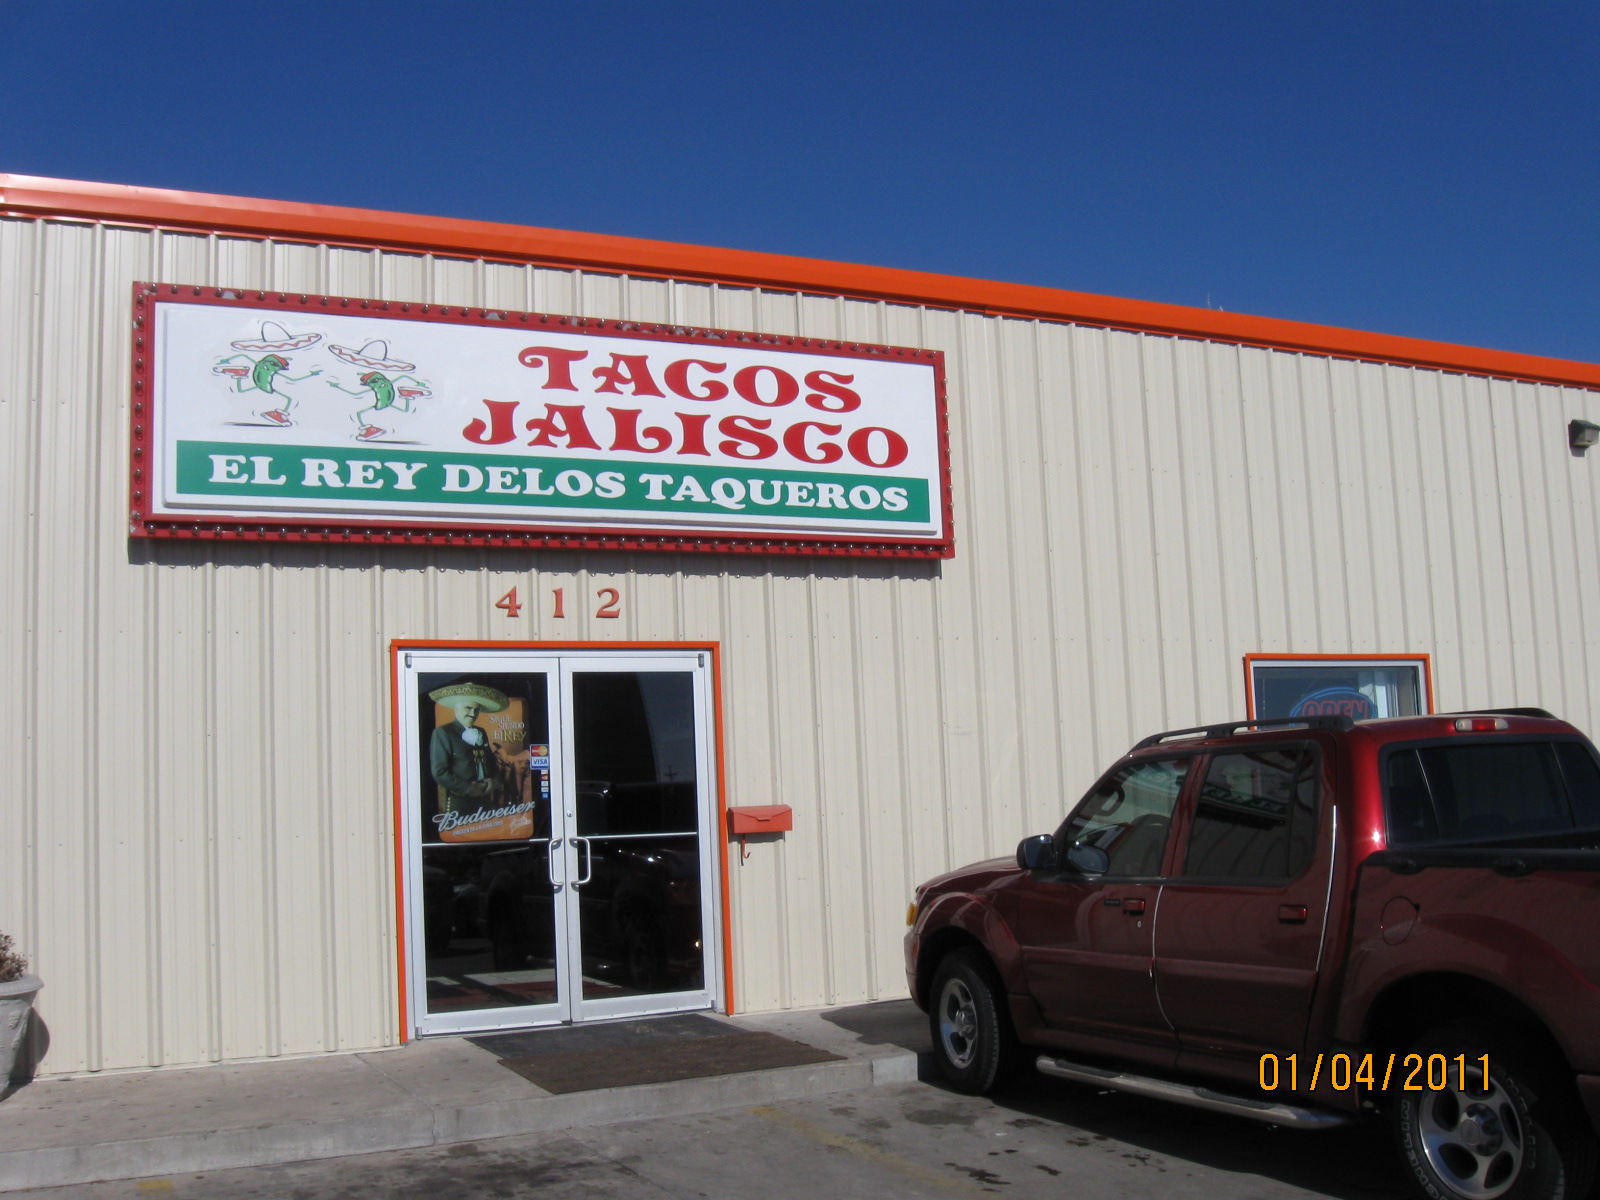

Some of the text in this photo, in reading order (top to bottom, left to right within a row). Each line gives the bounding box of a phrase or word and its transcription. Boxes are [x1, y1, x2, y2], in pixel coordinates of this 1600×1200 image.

[518, 346, 862, 413] TACOS
[463, 399, 909, 468] JALISCO
[208, 454, 910, 512] EL REY DELOS TAQUEROS
[432, 801, 535, 832] Budweiser
